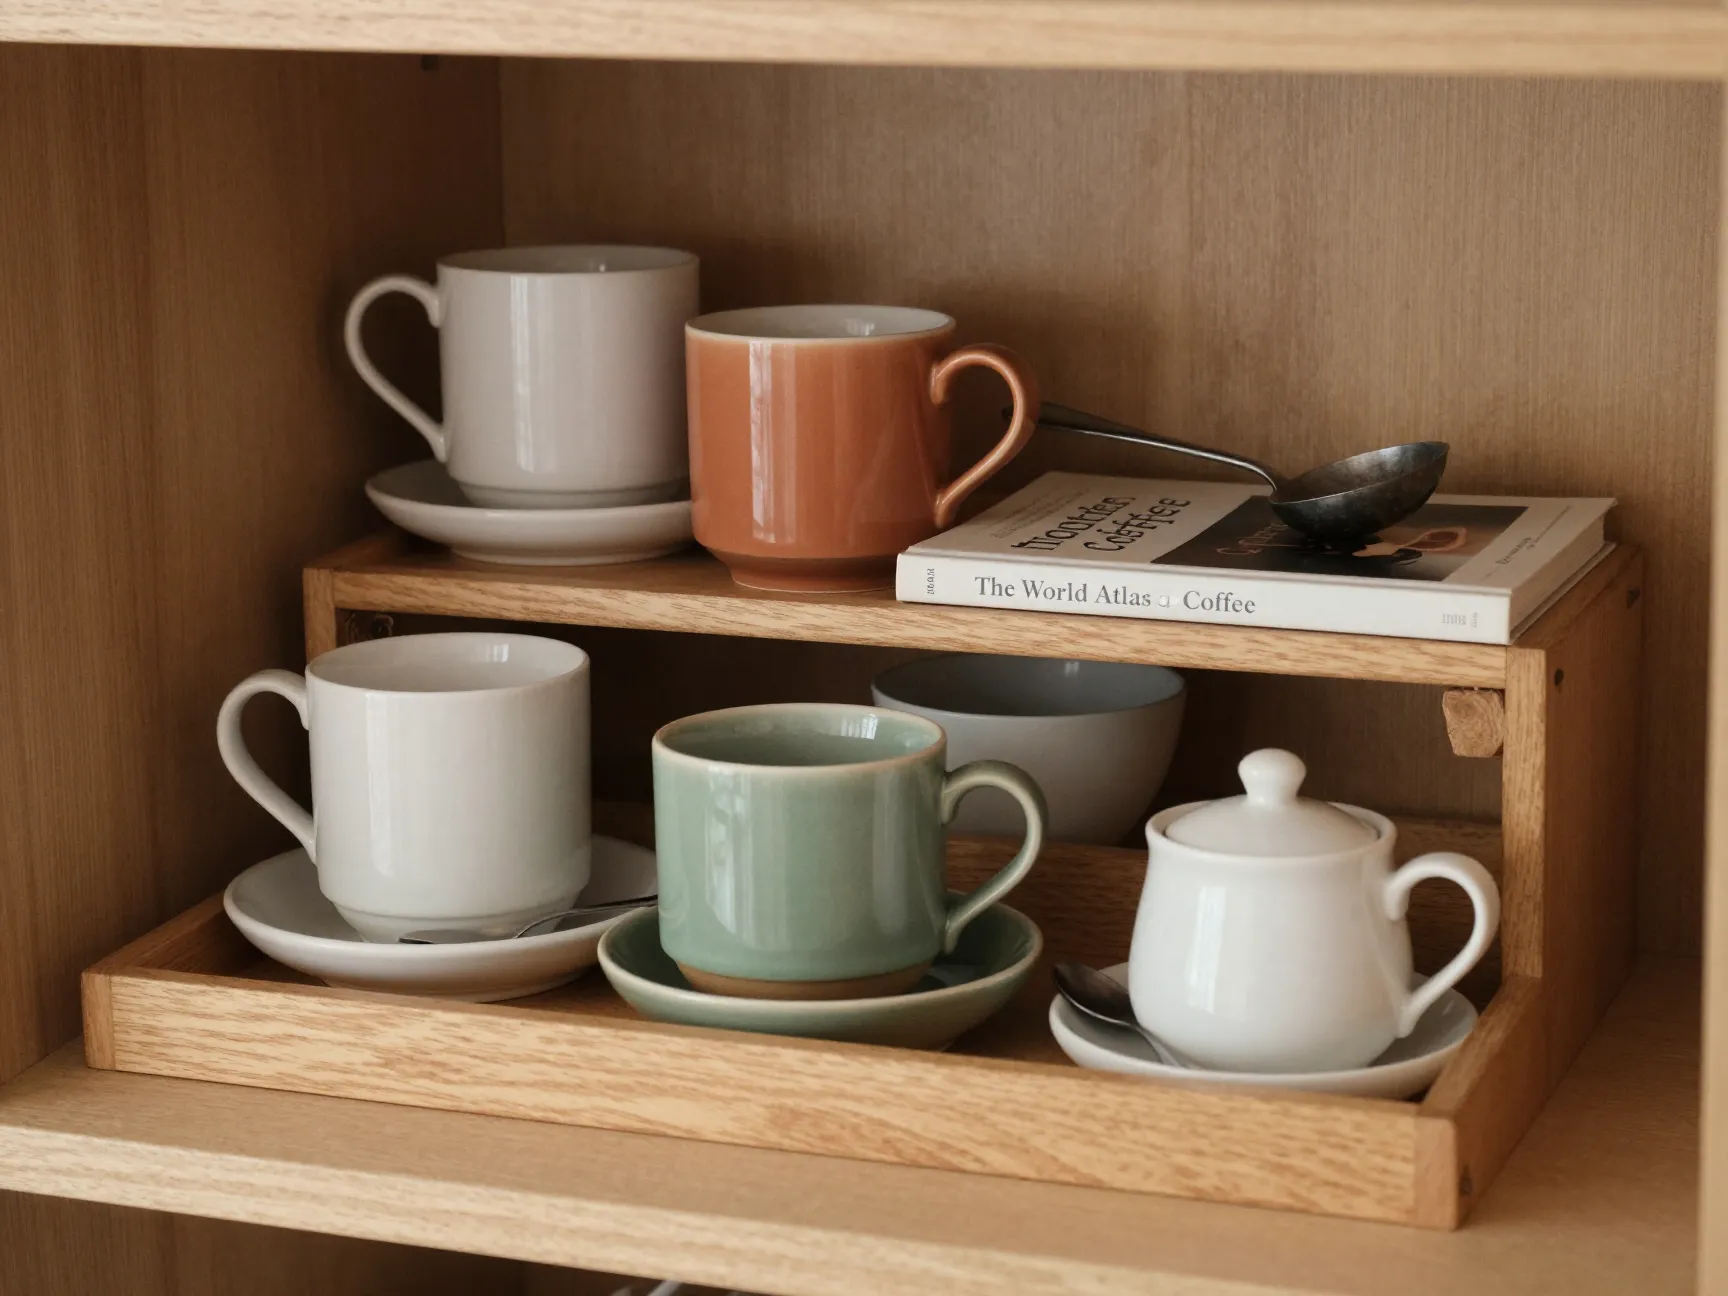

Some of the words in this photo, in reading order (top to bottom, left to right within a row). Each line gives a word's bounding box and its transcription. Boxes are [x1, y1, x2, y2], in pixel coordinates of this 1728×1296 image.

[975, 577, 1014, 597] The
[1022, 580, 1087, 602] World
[1095, 585, 1151, 606] Atlas
[1183, 591, 1255, 613] Coffee
